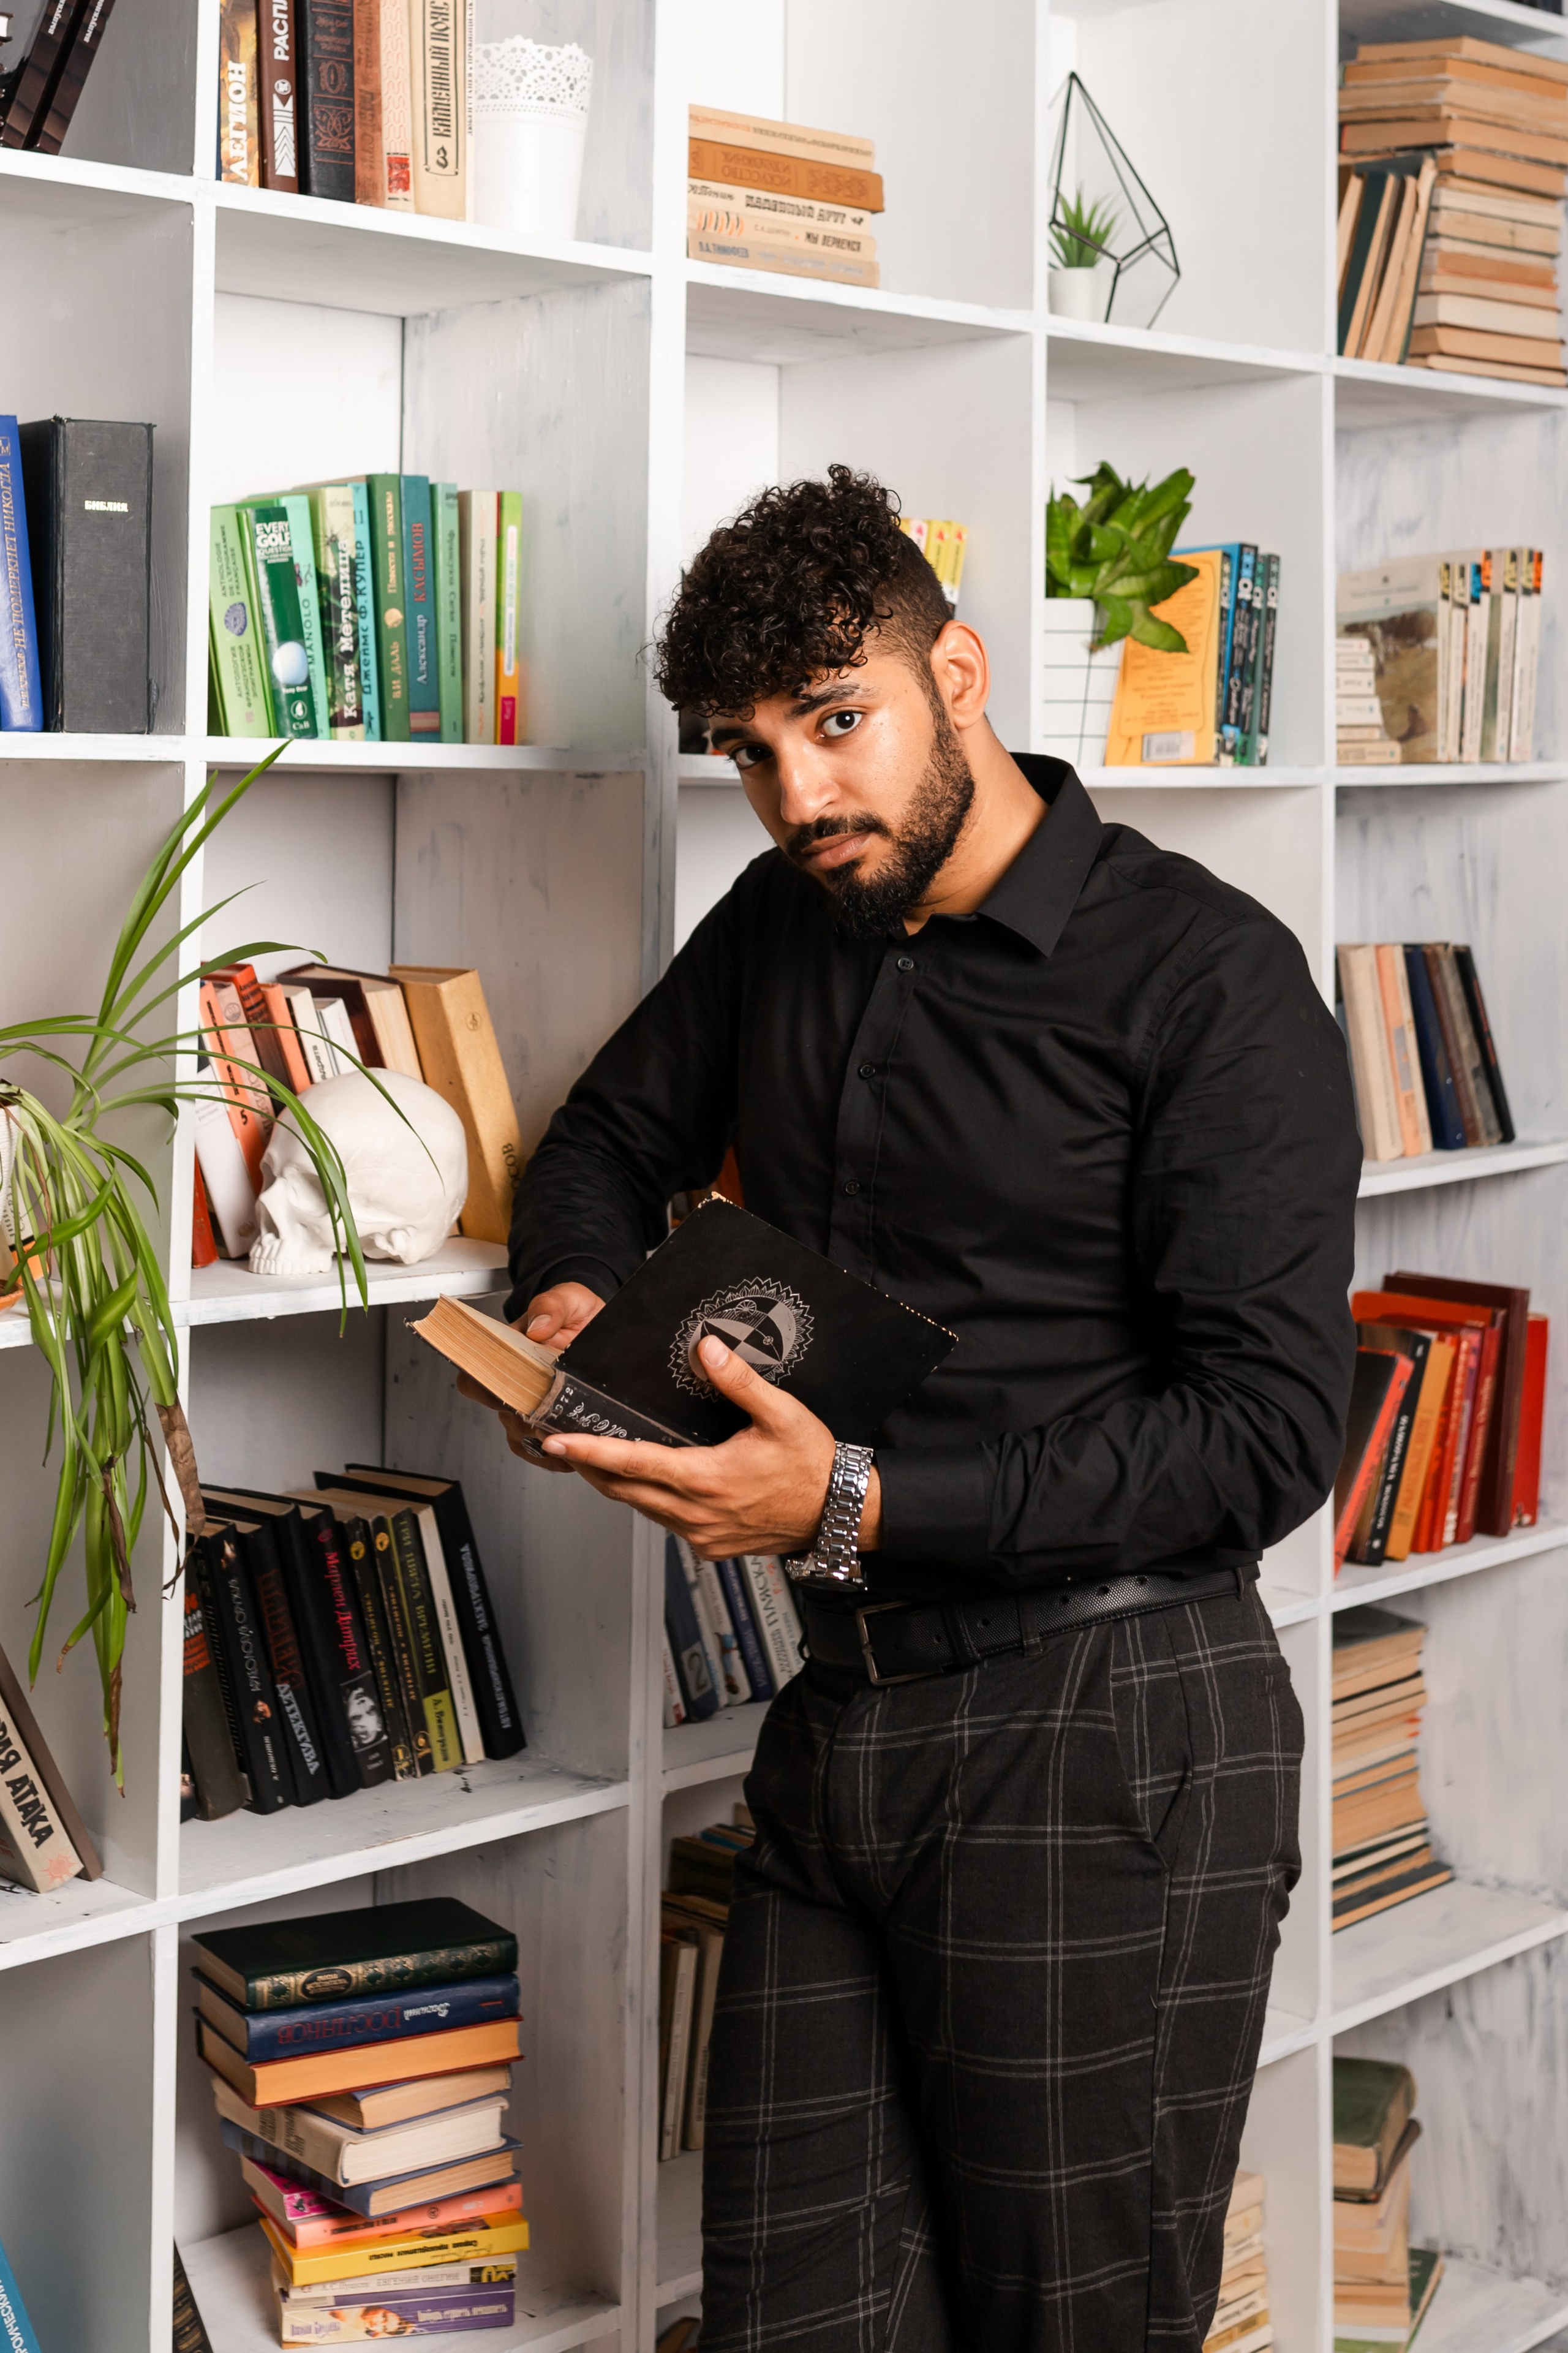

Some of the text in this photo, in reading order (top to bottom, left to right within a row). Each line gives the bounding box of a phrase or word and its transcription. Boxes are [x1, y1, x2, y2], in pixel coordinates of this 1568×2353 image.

[273, 0, 290, 61] РАСП
[228, 60, 248, 181] ЛЕГИОН
[429, 45, 452, 138] КАМЕННЫЙ
[1, 462, 16, 532] НИКОГДА
[84, 500, 129, 513] БИБЛИЯ
[255, 521, 289, 535] EVERY
[256, 532, 292, 548] GOLF
[6, 534, 25, 625] ПОМЕРКНЕТ
[411, 522, 429, 686] Александр КАСЫМОВ
[13, 628, 26, 651] НЕ
[301, 598, 316, 666] MANOLO
[337, 539, 358, 719] Катя Метелица
[360, 625, 372, 696] Джеймс
[239, 1108, 249, 1126] 5
[324, 1551, 361, 1671] Марлен Дитрих
[276, 1683, 321, 1775] ДЕТЕКТИВА
[4, 1773, 55, 1849] АТАКА
[277, 2005, 403, 2045] РОСЛЯКОВ
